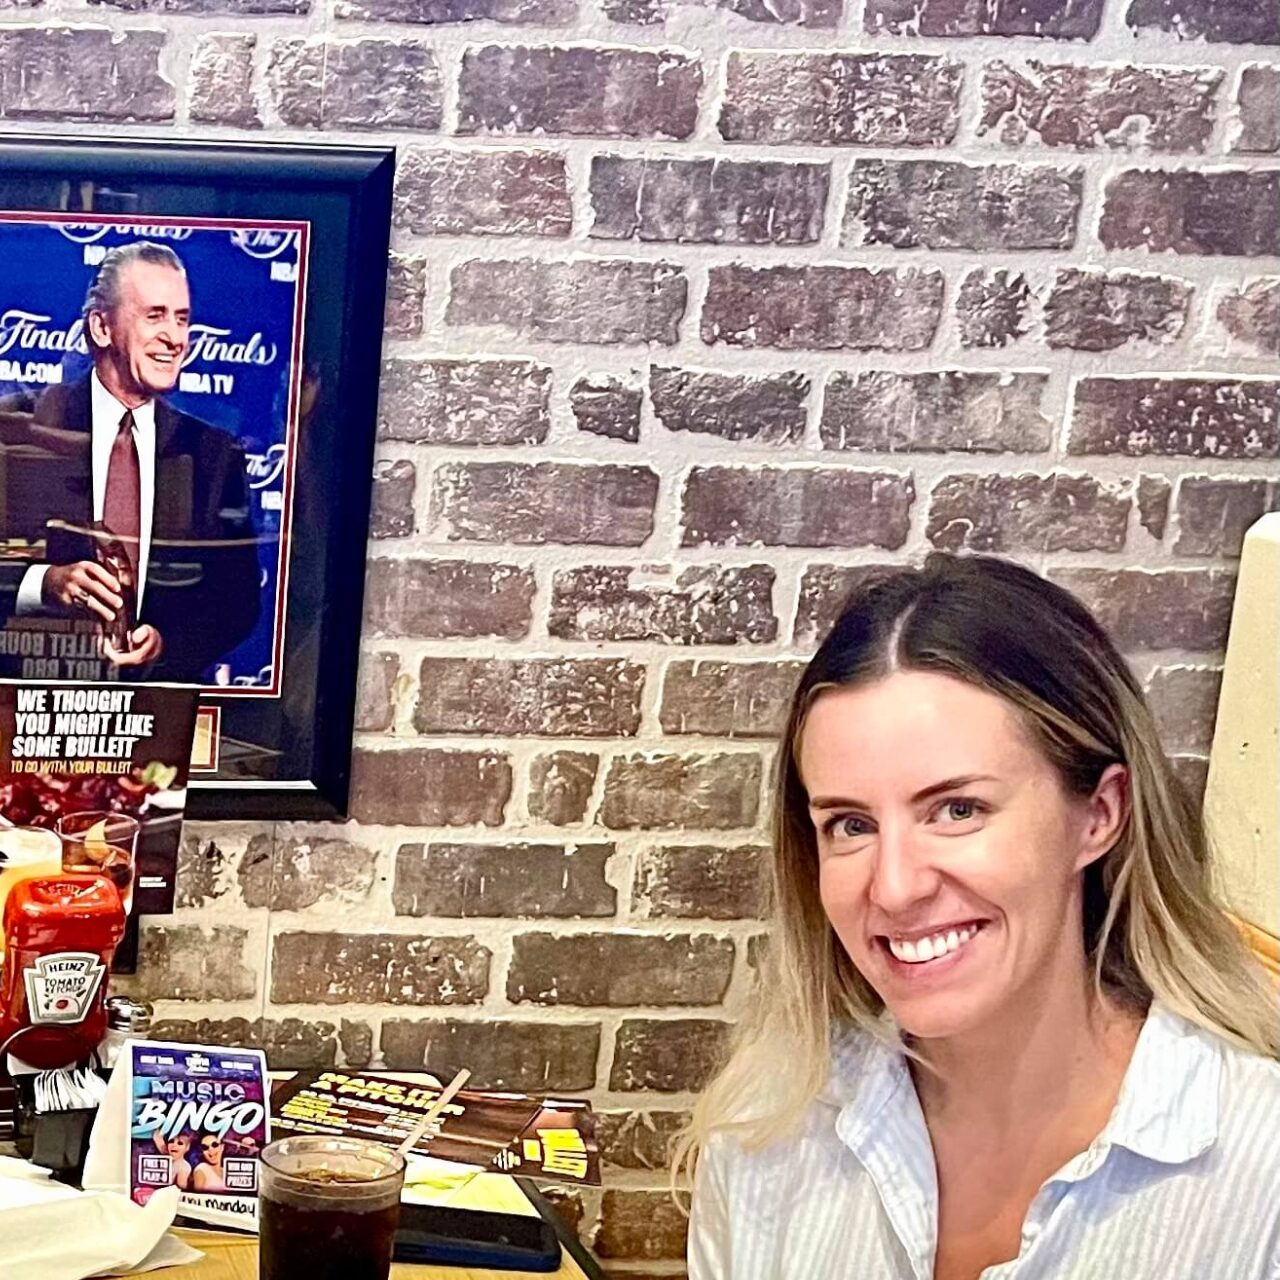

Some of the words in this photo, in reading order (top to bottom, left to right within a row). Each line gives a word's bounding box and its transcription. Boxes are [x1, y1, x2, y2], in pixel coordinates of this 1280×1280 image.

[3, 309, 90, 353] Finals
[180, 323, 278, 366] Finals
[179, 372, 210, 393] NBA
[211, 374, 234, 395] TV
[17, 689, 47, 712] WE
[52, 690, 135, 713] THOUGHT
[15, 713, 51, 735] YOU
[54, 713, 112, 735] MIGHT
[114, 714, 154, 736] LIKE
[12, 736, 61, 757] SOME
[65, 736, 140, 758] BULLEIT
[11, 761, 22, 773] TO
[25, 761, 38, 773] GO
[40, 761, 67, 773] WITH
[70, 761, 94, 773] YOUR
[96, 761, 132, 773] BULLEIT
[49, 962, 85, 972] HEINZ
[45, 976, 85, 988] TOMATO
[151, 1080, 246, 1103] MUSIC
[319, 1072, 407, 1094] MAKE
[133, 1098, 264, 1142] BINGO
